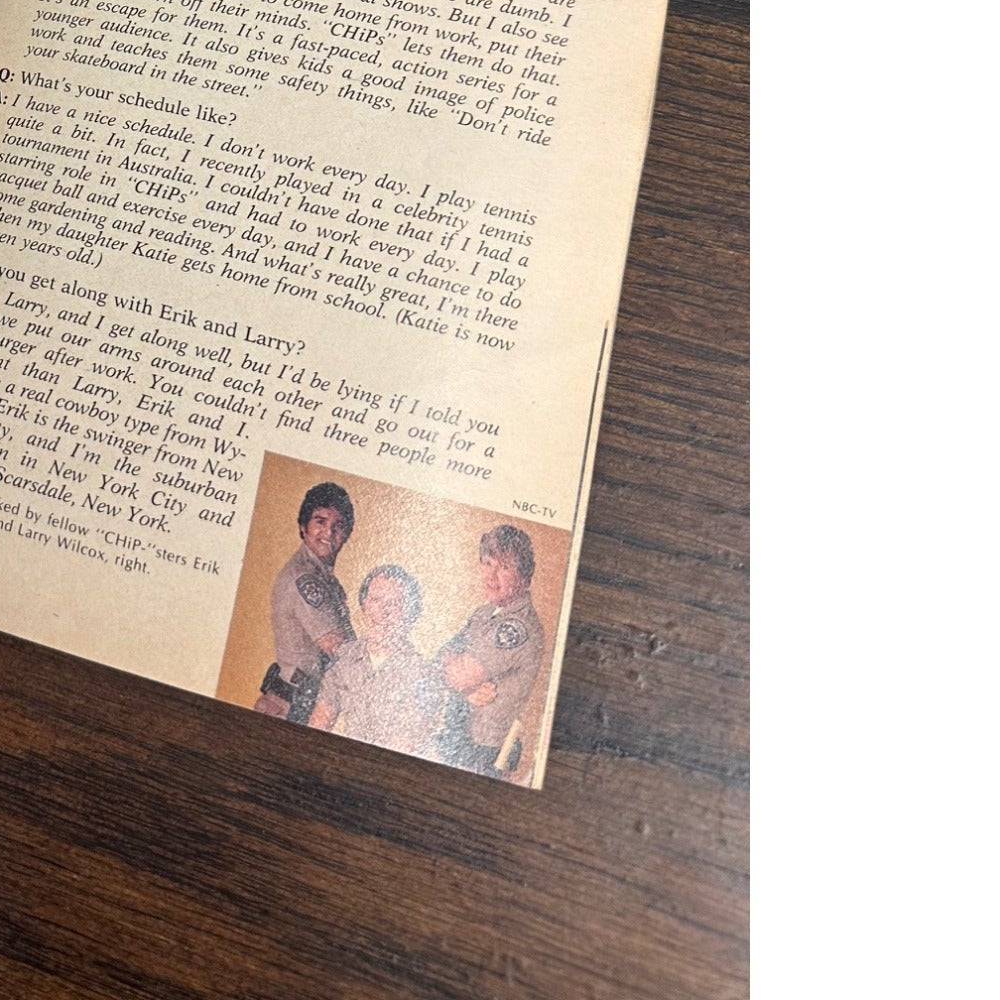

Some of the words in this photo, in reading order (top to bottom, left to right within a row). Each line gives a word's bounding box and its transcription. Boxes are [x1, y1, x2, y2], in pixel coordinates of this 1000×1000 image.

[23, 45, 61, 59] your
[62, 48, 148, 76] skateboard
[149, 64, 167, 80] in
[171, 69, 198, 86] the
[21, 70, 72, 93] What's
[74, 84, 115, 101] your
[117, 92, 191, 117] schedule
[195, 105, 237, 127] like?
[11, 93, 21, 107] I
[25, 95, 61, 115] have
[66, 108, 77, 119] a
[82, 109, 117, 127] nice
[122, 119, 196, 145] schedule.
[203, 133, 215, 148] I
[220, 138, 265, 160] don't
[272, 152, 316, 172] work
[321, 165, 368, 187] every
[374, 173, 411, 196] day.
[420, 184, 430, 199] I
[435, 190, 476, 213] play
[483, 202, 538, 226] tennis
[18, 238, 63, 257] years
[65, 247, 103, 269] old.)
[29, 274, 56, 291] get
[60, 281, 109, 308] along
[114, 296, 153, 316] with
[159, 304, 197, 328] Erik
[202, 319, 238, 338] and
[243, 326, 306, 356] Larry?
[43, 348, 84, 368] after
[92, 362, 137, 384] work.
[149, 374, 184, 397] You
[193, 391, 268, 420] couldn't
[277, 410, 315, 433] find
[323, 424, 369, 448] three
[376, 441, 436, 466] people
[446, 459, 493, 480] more
[33, 413, 49, 426] is
[52, 417, 80, 436] the
[83, 428, 152, 456] swinger
[154, 445, 198, 470] from
[201, 458, 244, 482] New
[513, 499, 557, 518] NBC-TV
[17, 523, 52, 546] Larry
[57, 534, 109, 564] Wilcox,
[114, 553, 150, 575] right.
[24, 505, 42, 524] by
[47, 512, 90, 536] fellow
[193, 556, 220, 576] Erik
